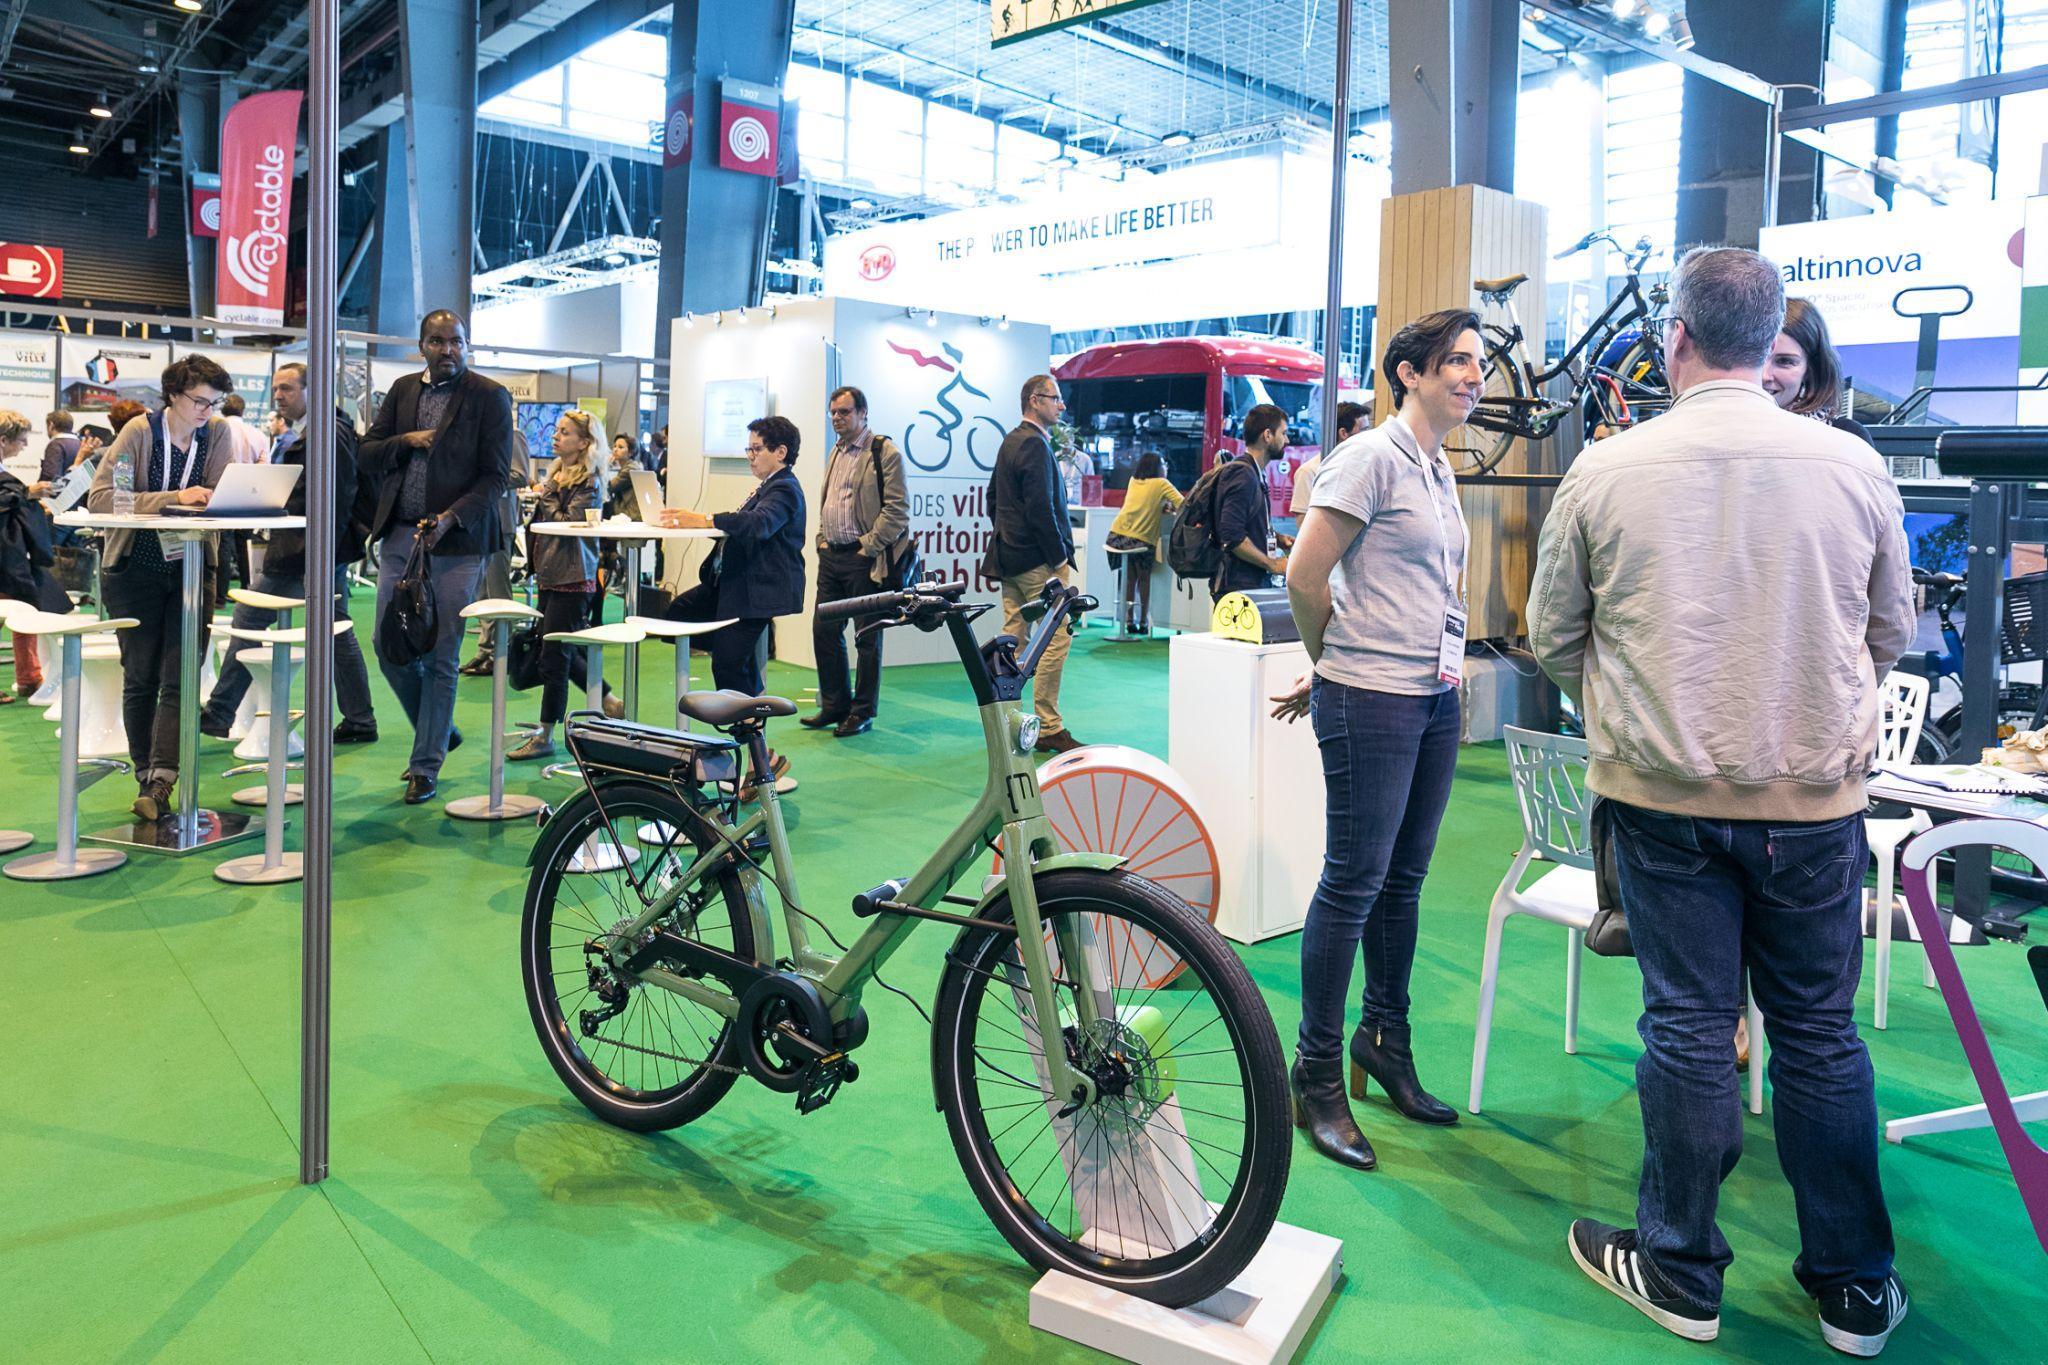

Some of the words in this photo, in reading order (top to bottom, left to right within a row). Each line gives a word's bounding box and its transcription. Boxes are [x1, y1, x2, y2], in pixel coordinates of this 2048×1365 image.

[254, 144, 287, 267] cyclable
[938, 240, 962, 261] THE
[1029, 224, 1048, 247] TO
[1053, 215, 1100, 244] MAKE
[1105, 209, 1138, 236] LIFE
[1143, 197, 1213, 231] BETTER
[1782, 252, 1922, 283] altinnova
[913, 494, 945, 517] DES
